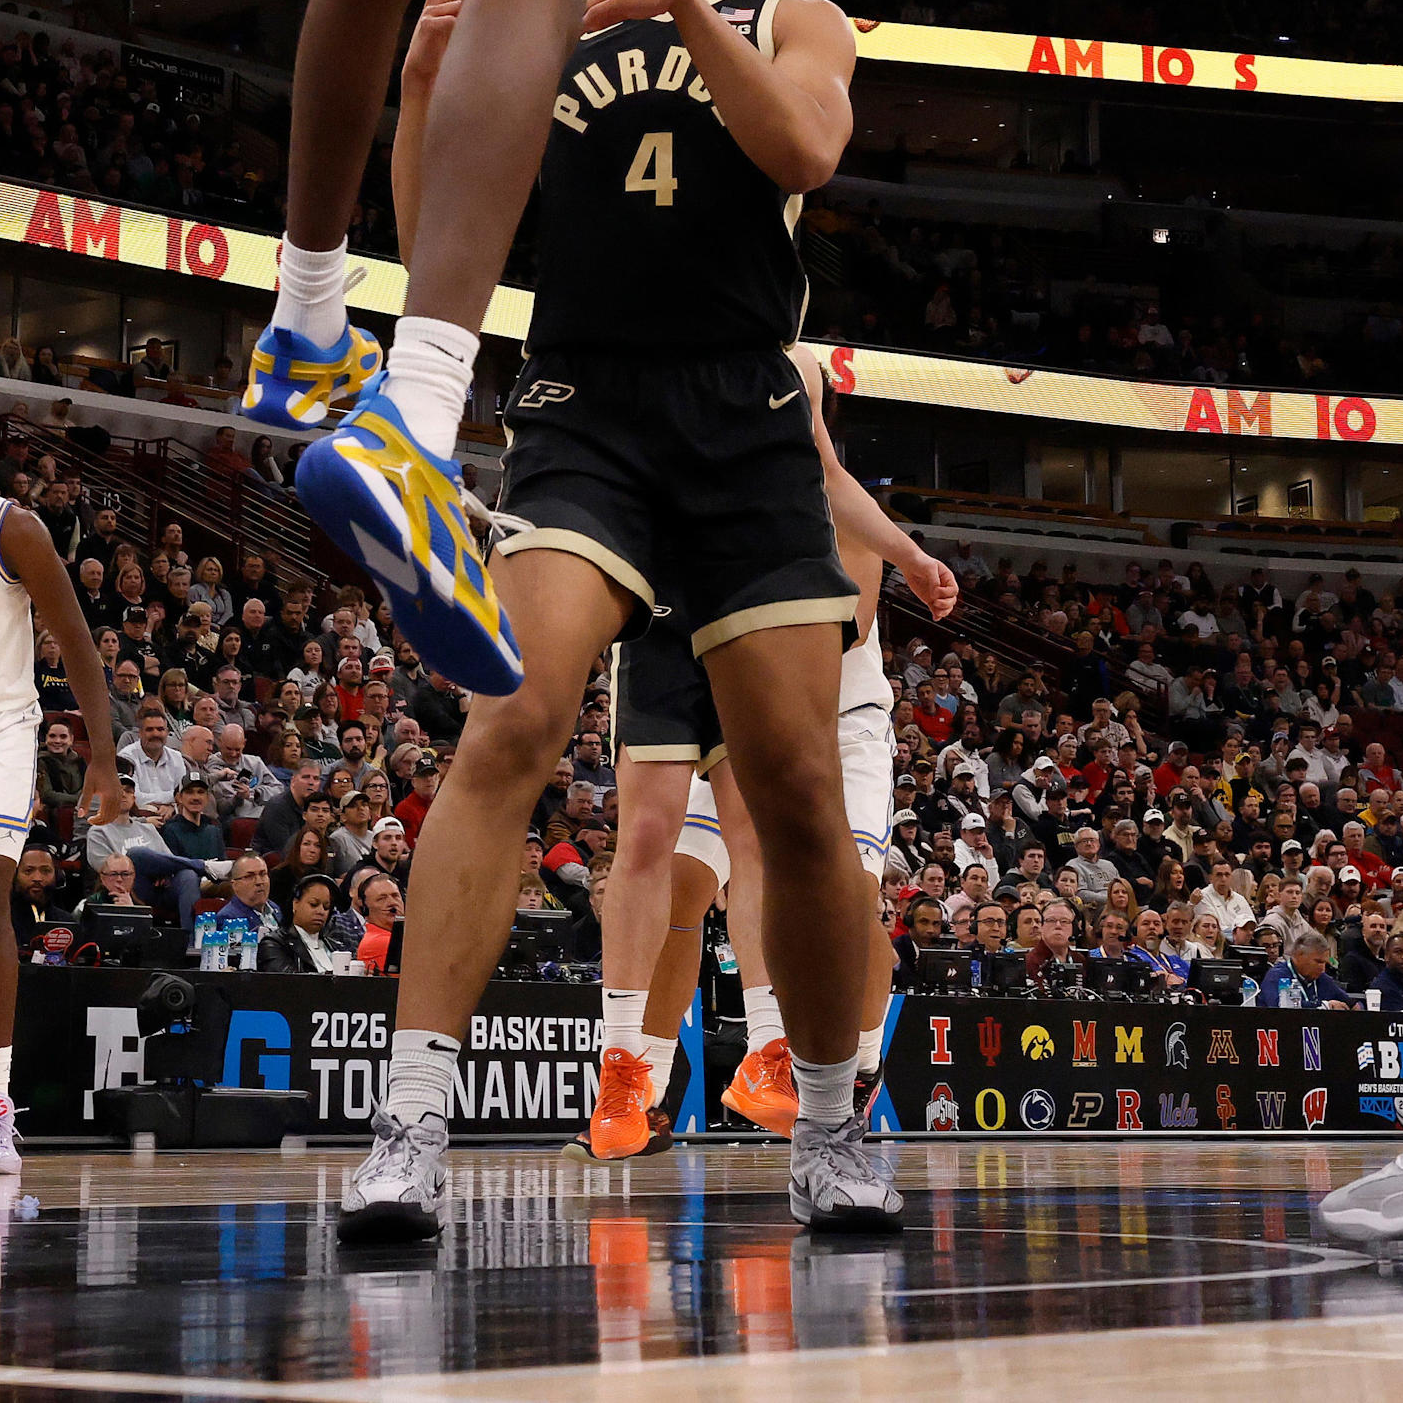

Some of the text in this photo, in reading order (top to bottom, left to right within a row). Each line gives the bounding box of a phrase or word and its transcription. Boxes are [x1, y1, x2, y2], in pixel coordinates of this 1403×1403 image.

[1029, 37, 1258, 92] AM IO S
[553, 47, 727, 133] PURD
[625, 132, 678, 207] 4
[26, 192, 121, 261] AM
[168, 220, 230, 279] IO
[517, 380, 576, 408] P
[832, 348, 857, 395] S
[1186, 389, 1272, 435] AM
[1317, 396, 1377, 443] IO
[311, 1012, 603, 1052] 2026 BASKETBA
[1115, 1026, 1144, 1063] M
[1207, 1029, 1239, 1065] M
[1256, 1029, 1280, 1067] N
[1302, 1027, 1322, 1071] N
[975, 1088, 1006, 1130] O
[1067, 1092, 1103, 1128] P
[1116, 1089, 1143, 1130] R
[1256, 1091, 1286, 1129] W
[1302, 1087, 1328, 1131] W
[1358, 1083, 1377, 1093] MEN'S
